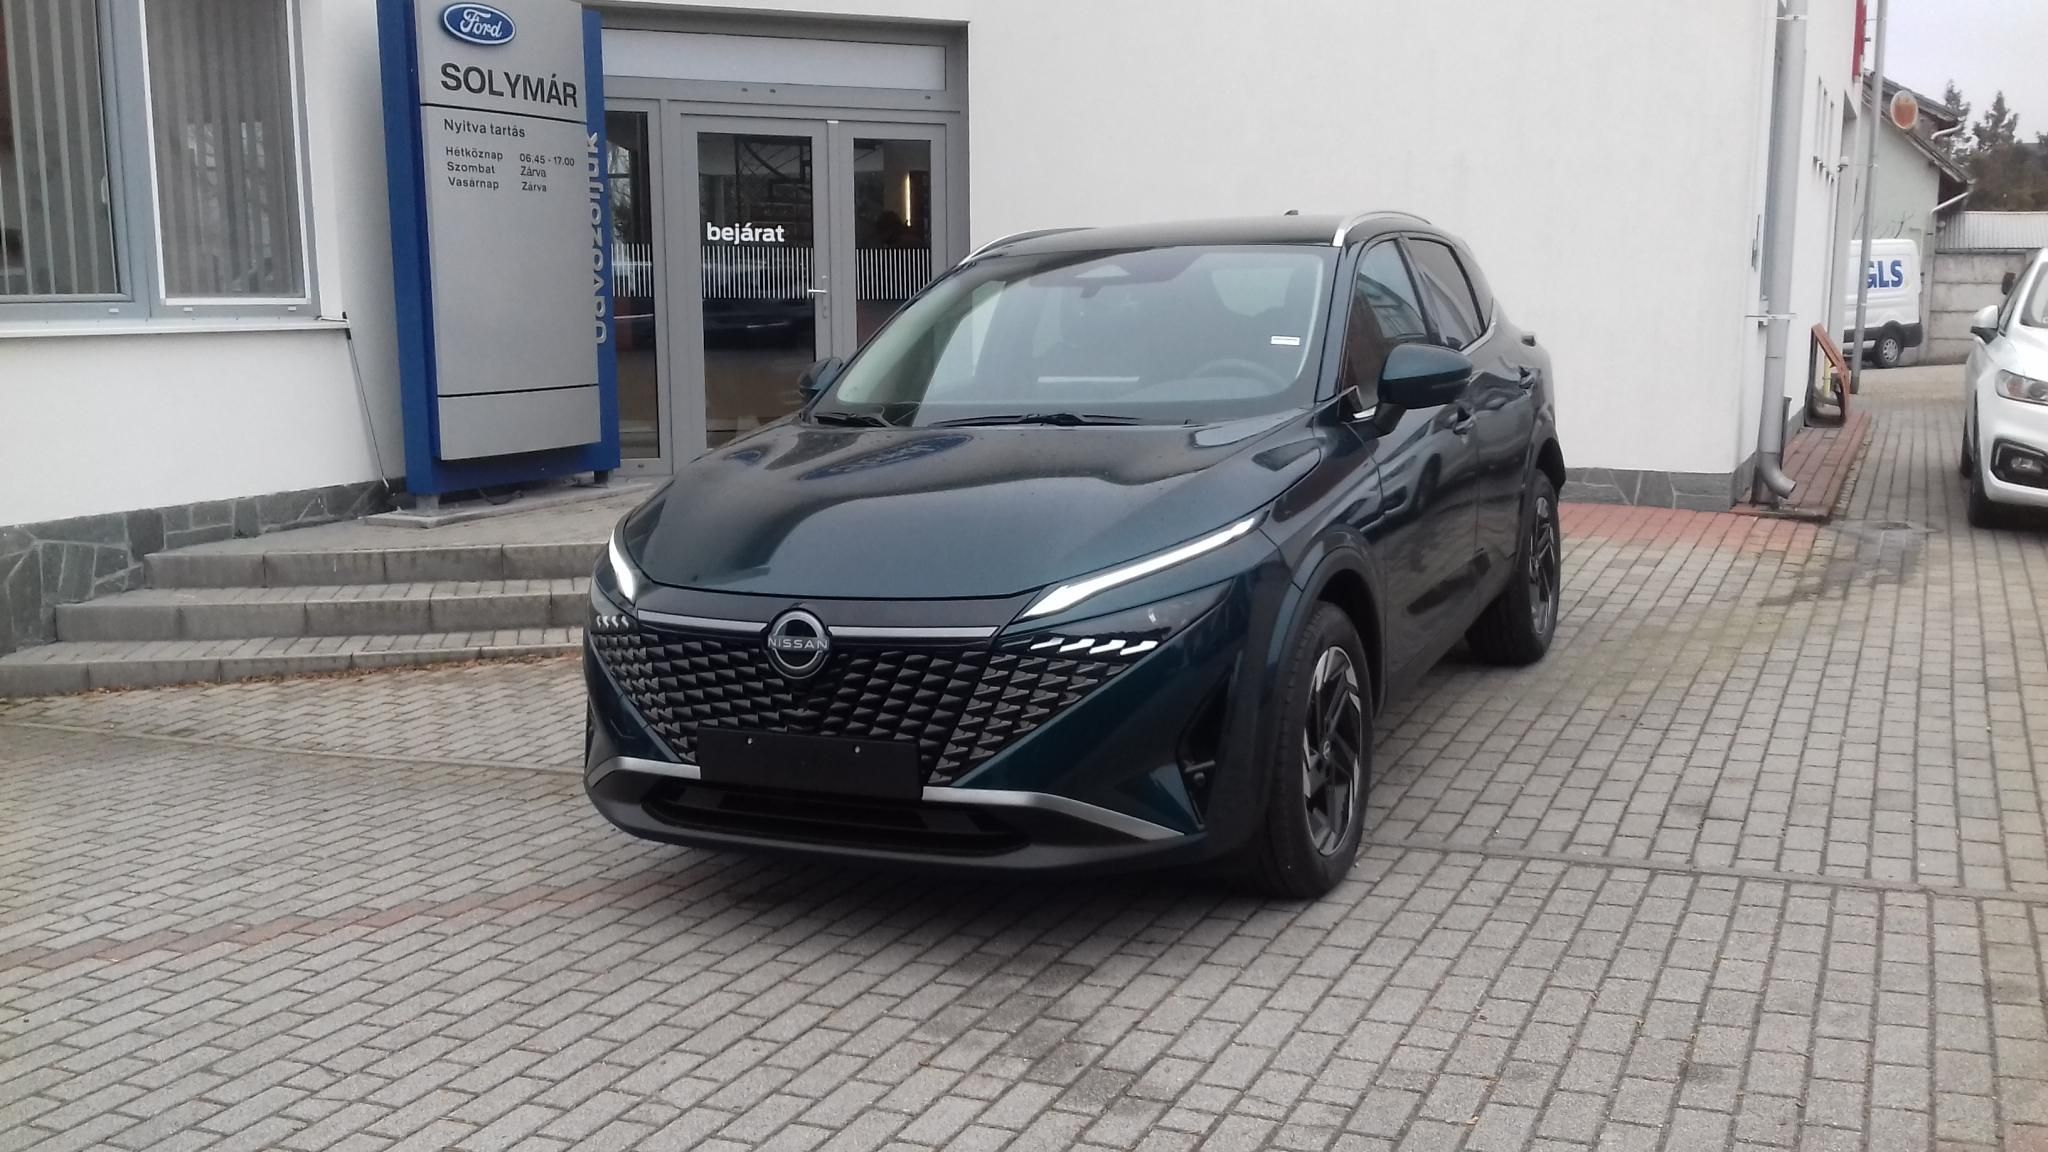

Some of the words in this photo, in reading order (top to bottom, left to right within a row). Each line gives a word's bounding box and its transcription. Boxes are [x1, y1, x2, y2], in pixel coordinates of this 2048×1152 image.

[460, 9, 503, 38] Ford
[440, 62, 578, 108] SOLYMÁR
[444, 118, 487, 134] Nyitva
[490, 124, 526, 138] tartás
[446, 147, 503, 160] Hétköznap
[520, 153, 546, 164] 06.45
[554, 156, 575, 166] 17.00
[447, 162, 496, 174] Szombat
[520, 166, 547, 177] Zárva
[448, 177, 499, 190] Vasárnap
[521, 182, 547, 192] Zárva
[706, 222, 785, 245] bejárat
[767, 637, 828, 649] NISSAN
